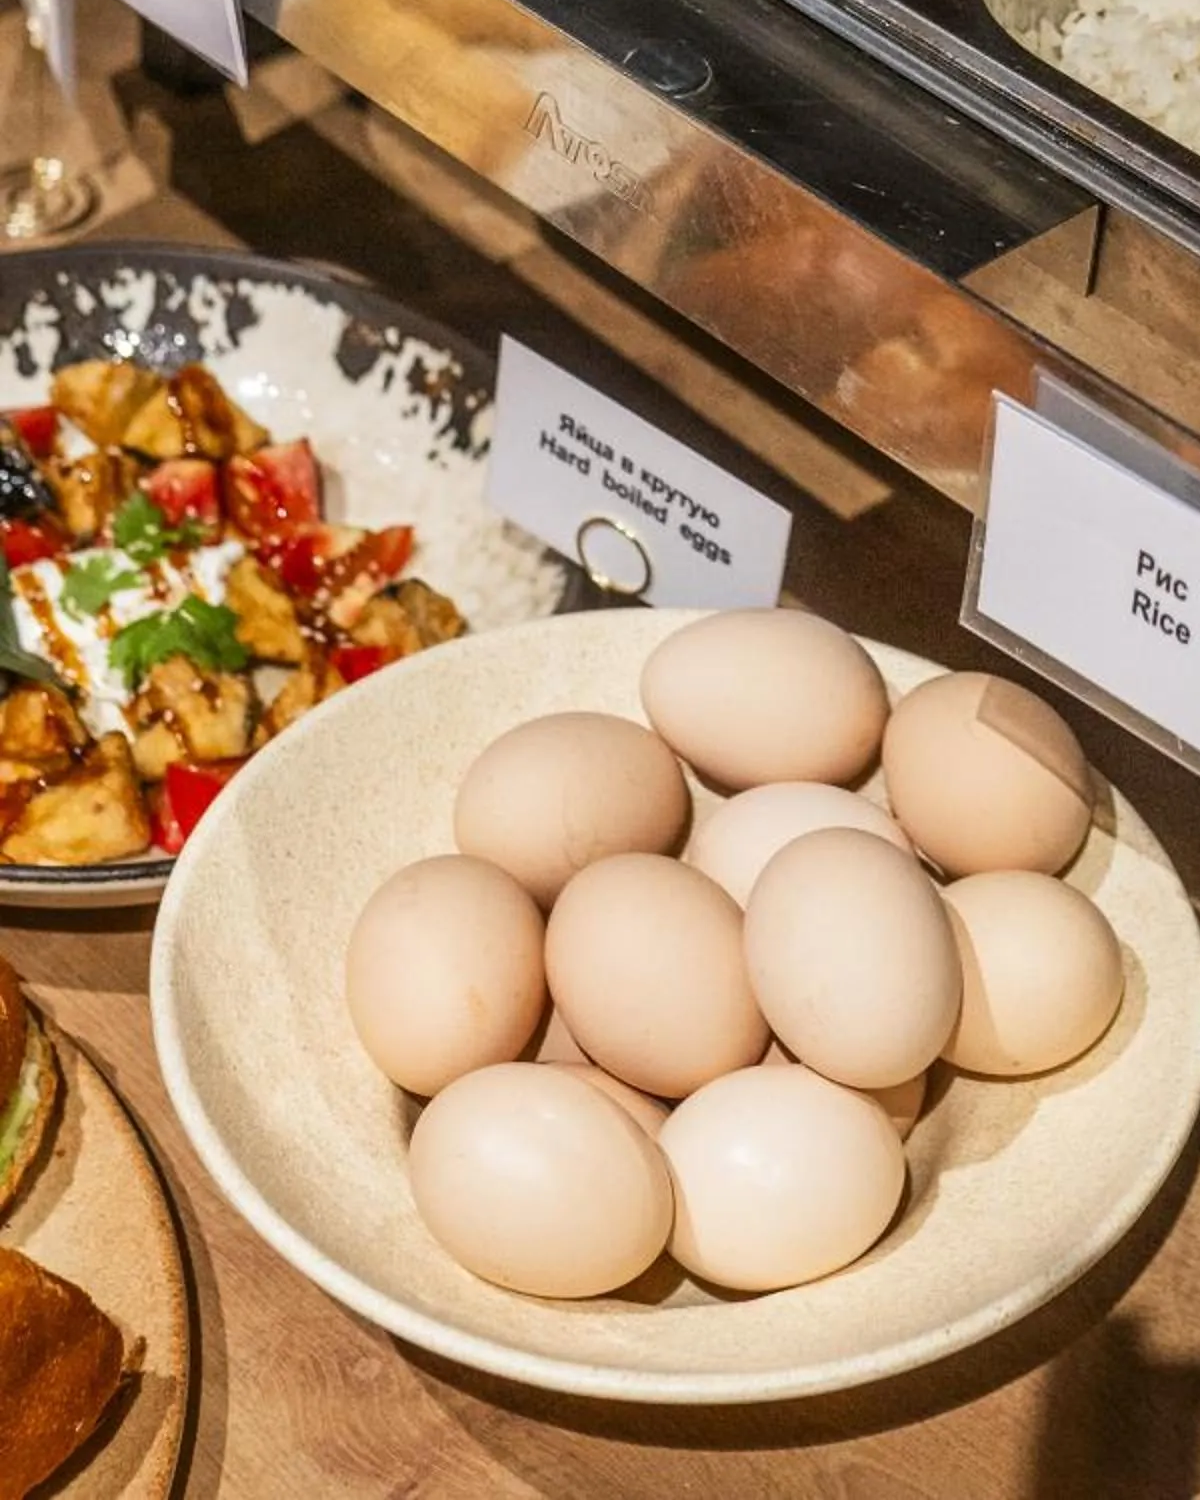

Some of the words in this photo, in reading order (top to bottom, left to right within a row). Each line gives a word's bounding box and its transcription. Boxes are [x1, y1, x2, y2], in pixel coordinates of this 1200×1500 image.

[540, 430, 590, 475] Hard
[602, 470, 668, 524] boiled
[679, 522, 731, 565] eggs
[559, 413, 614, 461] Яйца
[621, 456, 633, 474] в
[641, 468, 720, 529] крутую
[1131, 588, 1191, 644] Rice
[1136, 549, 1188, 601] Рис
